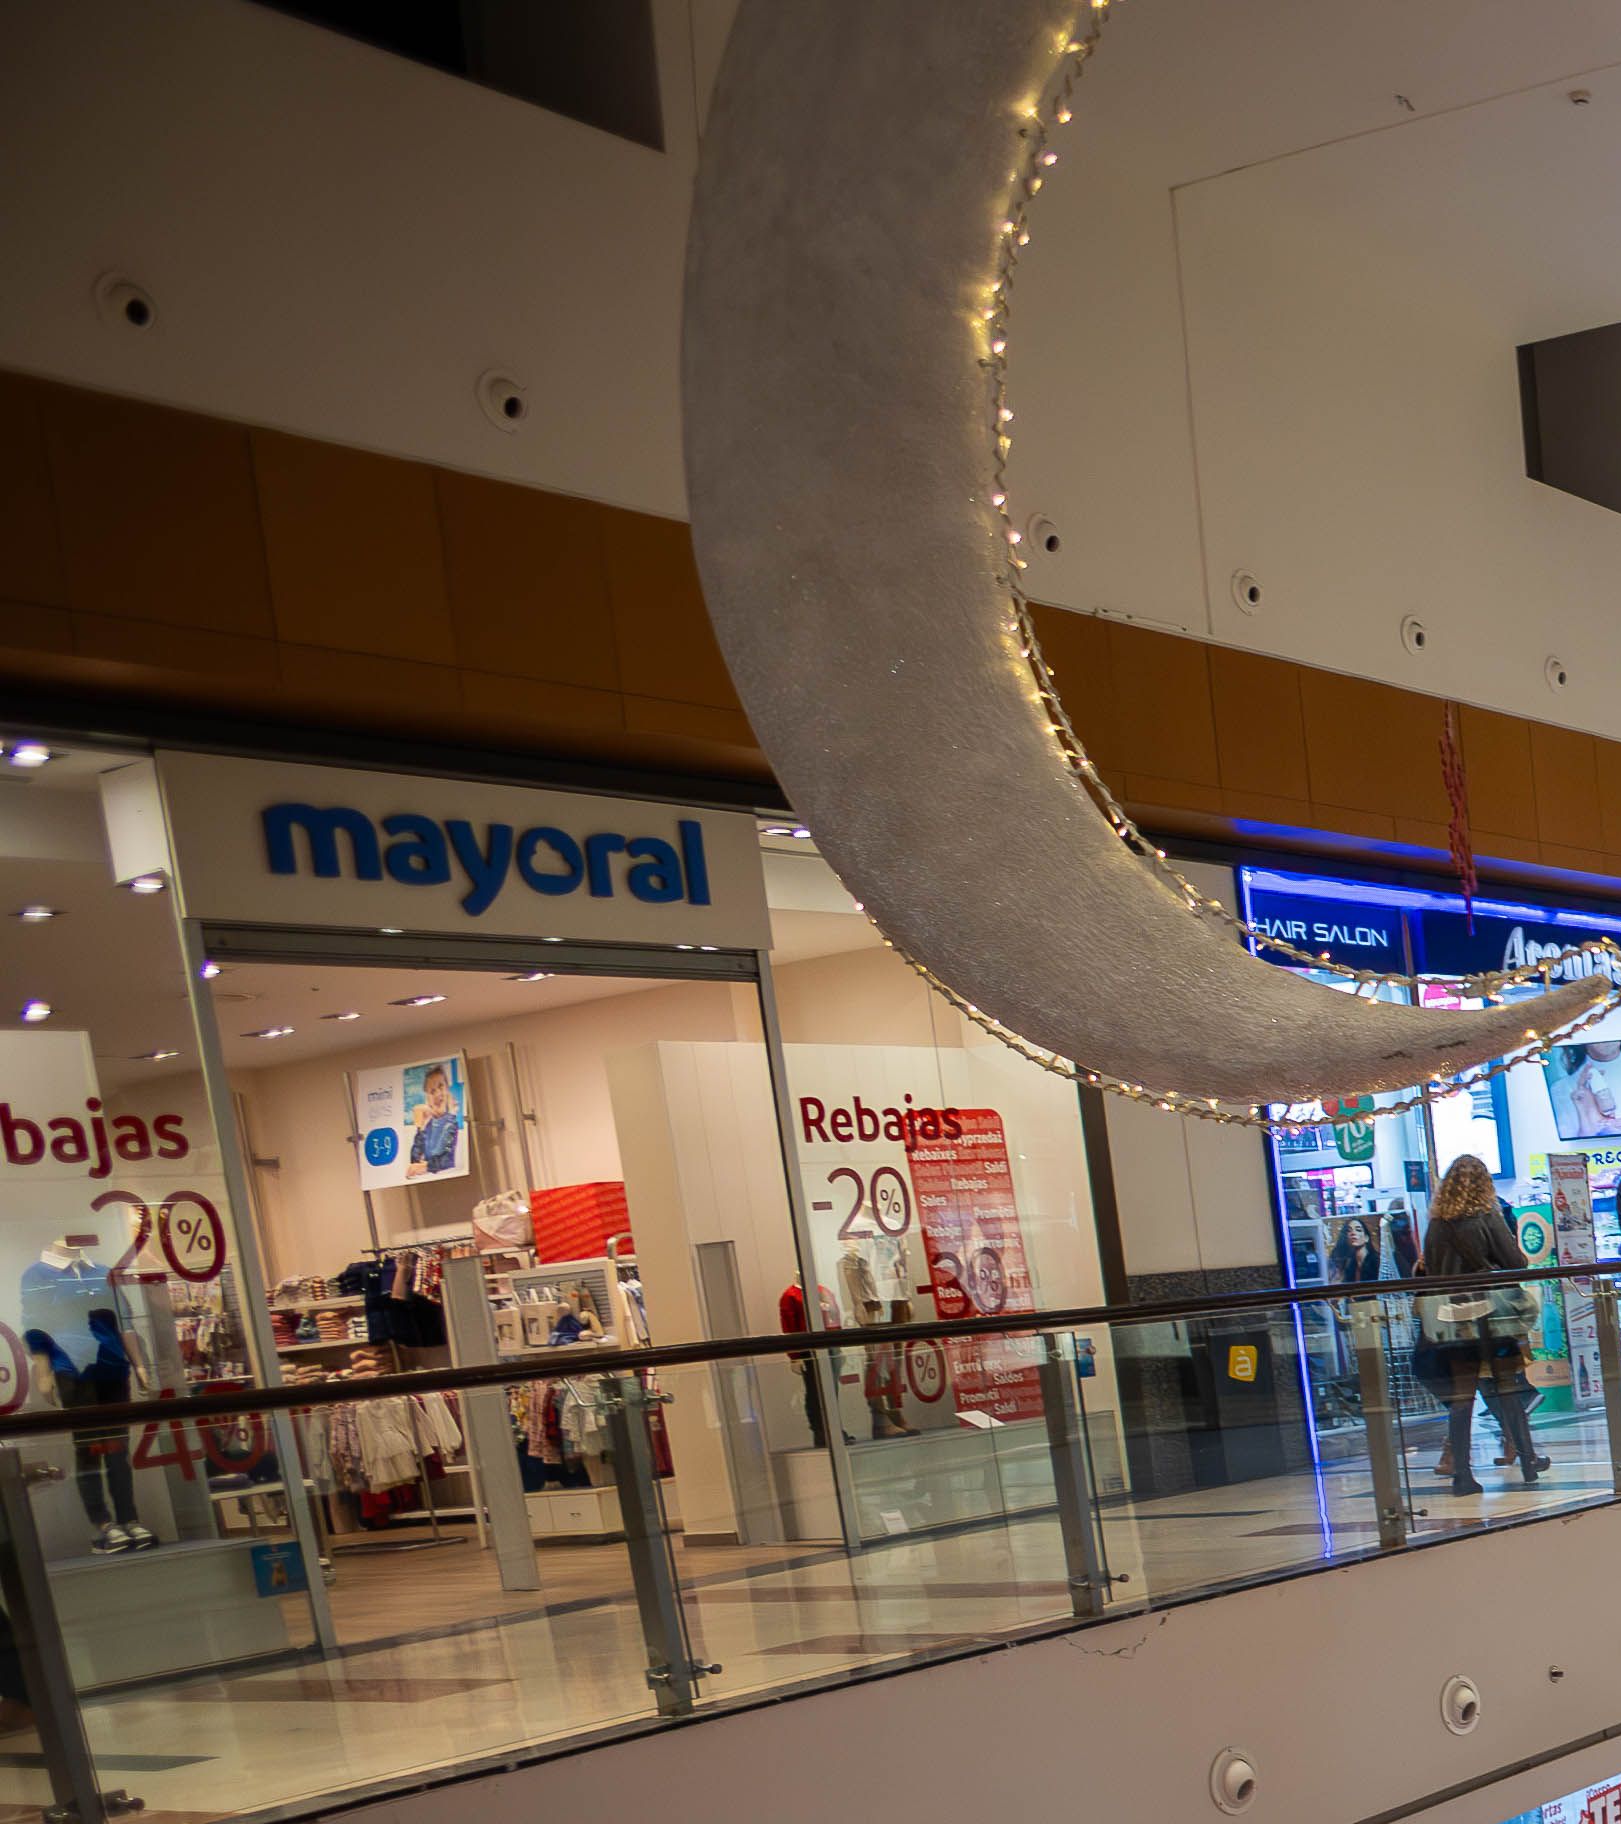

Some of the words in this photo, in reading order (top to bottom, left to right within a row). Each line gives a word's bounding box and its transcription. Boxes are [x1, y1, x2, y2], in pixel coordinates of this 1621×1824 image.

[261, 803, 711, 916] mayoral
[1255, 918, 1308, 940] HAIR
[1313, 923, 1388, 947] SALON
[799, 1094, 963, 1152] Rebajas
[812, 1167, 911, 1241] -20%
